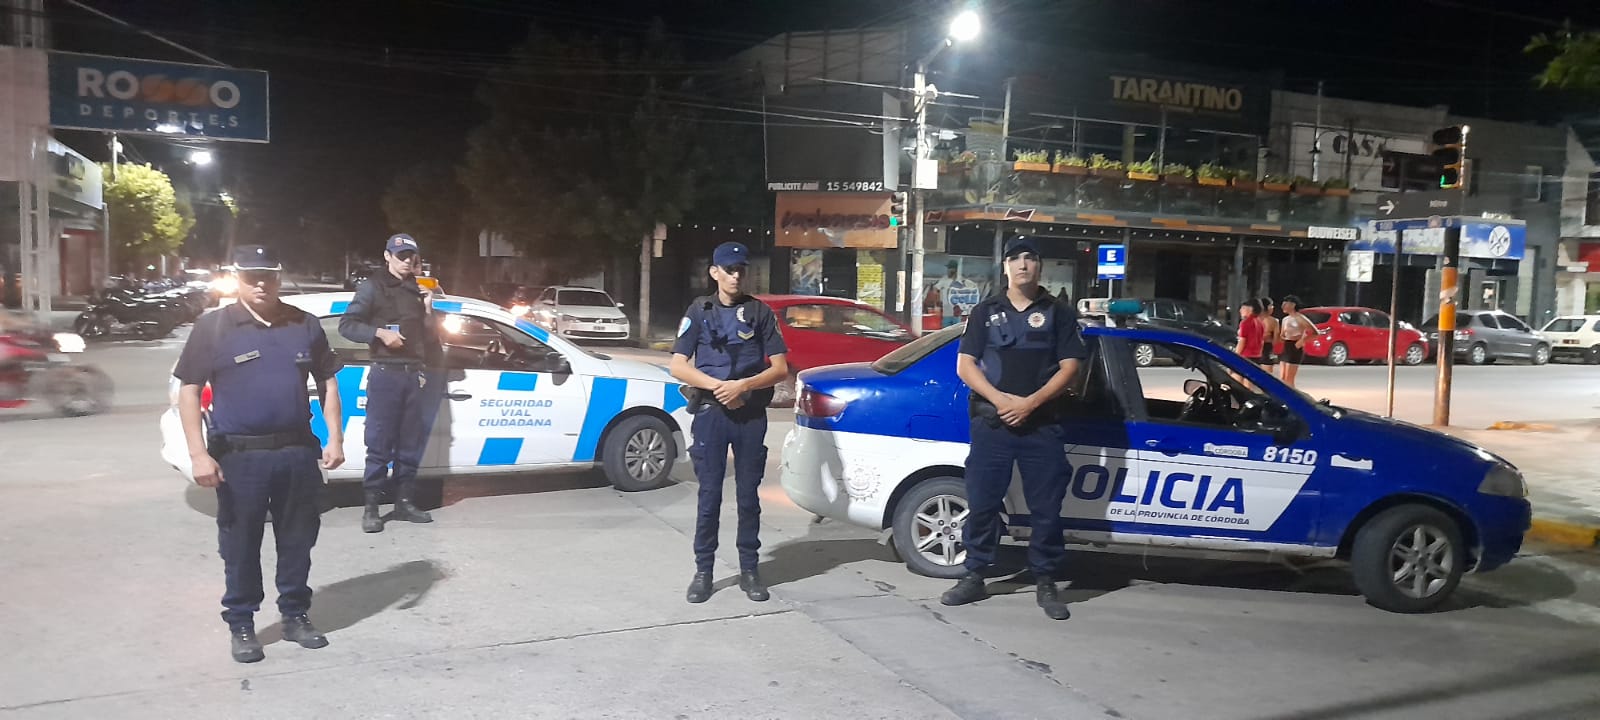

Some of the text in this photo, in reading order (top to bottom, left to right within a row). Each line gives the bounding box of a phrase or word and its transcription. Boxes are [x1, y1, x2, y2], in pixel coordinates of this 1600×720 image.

[1110, 75, 1243, 111] TARANTINO
[80, 103, 239, 127] DEPORTES
[827, 182, 840, 191] 15
[842, 182, 883, 191] 549842
[1106, 249, 1117, 262] E
[480, 399, 553, 408] SEGURIDAD
[501, 409, 532, 417] VIAL
[478, 418, 552, 427] CIUDADANA
[1263, 446, 1318, 466] 8150
[1071, 464, 1246, 515] OLICIA
[1137, 510, 1189, 521] PROVINCIA
[1191, 514, 1203, 522] DE
